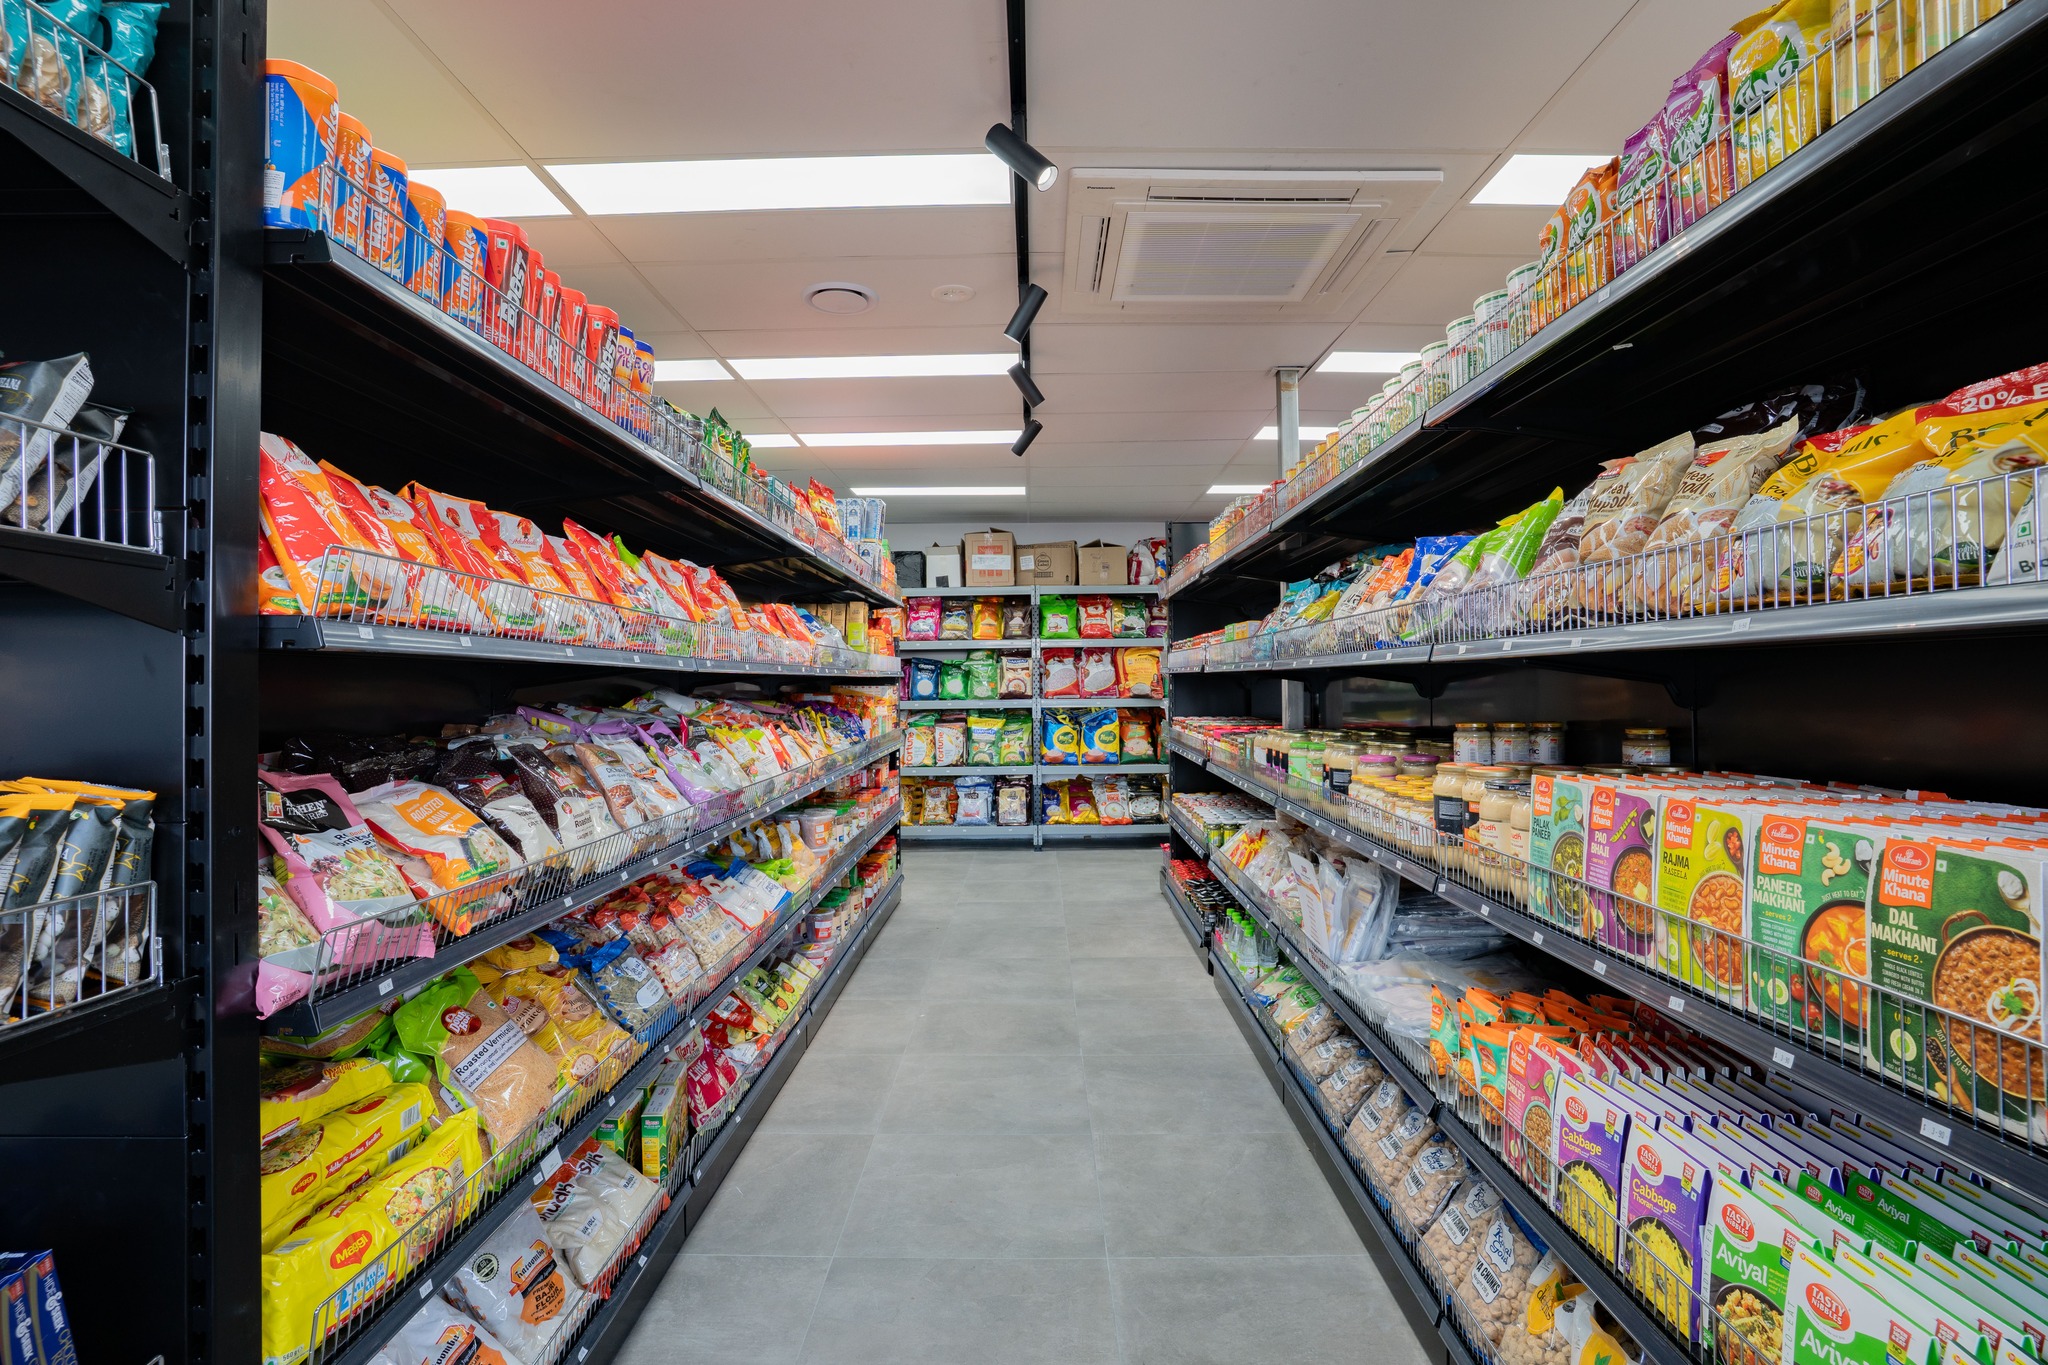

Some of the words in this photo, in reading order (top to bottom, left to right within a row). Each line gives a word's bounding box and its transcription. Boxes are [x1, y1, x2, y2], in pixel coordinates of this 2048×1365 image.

[1961, 391, 2022, 414] 20%
[905, 731, 915, 767] fortune
[936, 731, 945, 763] fortune
[410, 797, 445, 823] ROASTED
[427, 809, 451, 826] RAVA
[1531, 827, 1551, 841] PANEER
[1533, 817, 1550, 830] PALAK
[1666, 821, 1692, 835] Minute
[1594, 831, 1607, 844] PAO
[1666, 831, 1690, 845] Khana
[1590, 843, 1610, 858] BHAJI
[1662, 851, 1690, 870] RAJMA
[1762, 842, 1800, 859] Minute
[1664, 866, 1688, 880] RASEELA
[1763, 854, 1797, 871] Khana
[1756, 875, 1802, 899] PANEER
[1884, 868, 1931, 889] Minute
[1753, 890, 1806, 915] MAKHANI
[1821, 893, 1832, 902] JUST
[1832, 890, 1843, 899] HEAT
[1844, 889, 1850, 897] TO
[1850, 889, 1860, 898] EAT
[1884, 883, 1926, 903] Khana
[1764, 910, 1787, 922] serves
[1787, 914, 1792, 923] 2
[1888, 907, 1918, 931] DAL
[1871, 921, 1938, 956] MAKHANI
[1887, 948, 1912, 963] serves
[1913, 954, 1920, 964] 2
[455, 1046, 489, 1077] Roasted
[488, 1023, 516, 1049] Vermicelli
[322, 1060, 359, 1080] Masala
[1954, 1056, 1962, 1066] TO
[1960, 1065, 1972, 1076] EAT
[1567, 1099, 1586, 1115] TASTY
[1561, 1126, 1603, 1156] Cabbage
[1561, 1138, 1582, 1156] Thoran
[1640, 1146, 1661, 1167] TASTY
[1632, 1178, 1677, 1214] Cabbage
[1632, 1191, 1655, 1210] Thoran
[1806, 1185, 1821, 1197] TASTY
[1858, 1185, 1874, 1198] TASTY
[1725, 1205, 1753, 1228] TASTY
[1824, 1198, 1856, 1226] Aviyal
[1877, 1198, 1910, 1226] Aviyal
[335, 1233, 369, 1265] Maggi
[1715, 1242, 1768, 1288] Aviyal
[43, 1273, 57, 1298] HIDE
[534, 1281, 556, 1303] BAJRI
[1480, 1268, 1501, 1295] CHUNKS
[45, 1291, 62, 1311] &
[535, 1286, 560, 1311] FLOUR
[1810, 1285, 1847, 1317] TASTY
[14, 1298, 27, 1324] HIDE
[50, 1303, 65, 1334] SEEK
[20, 1330, 34, 1363] SEEK
